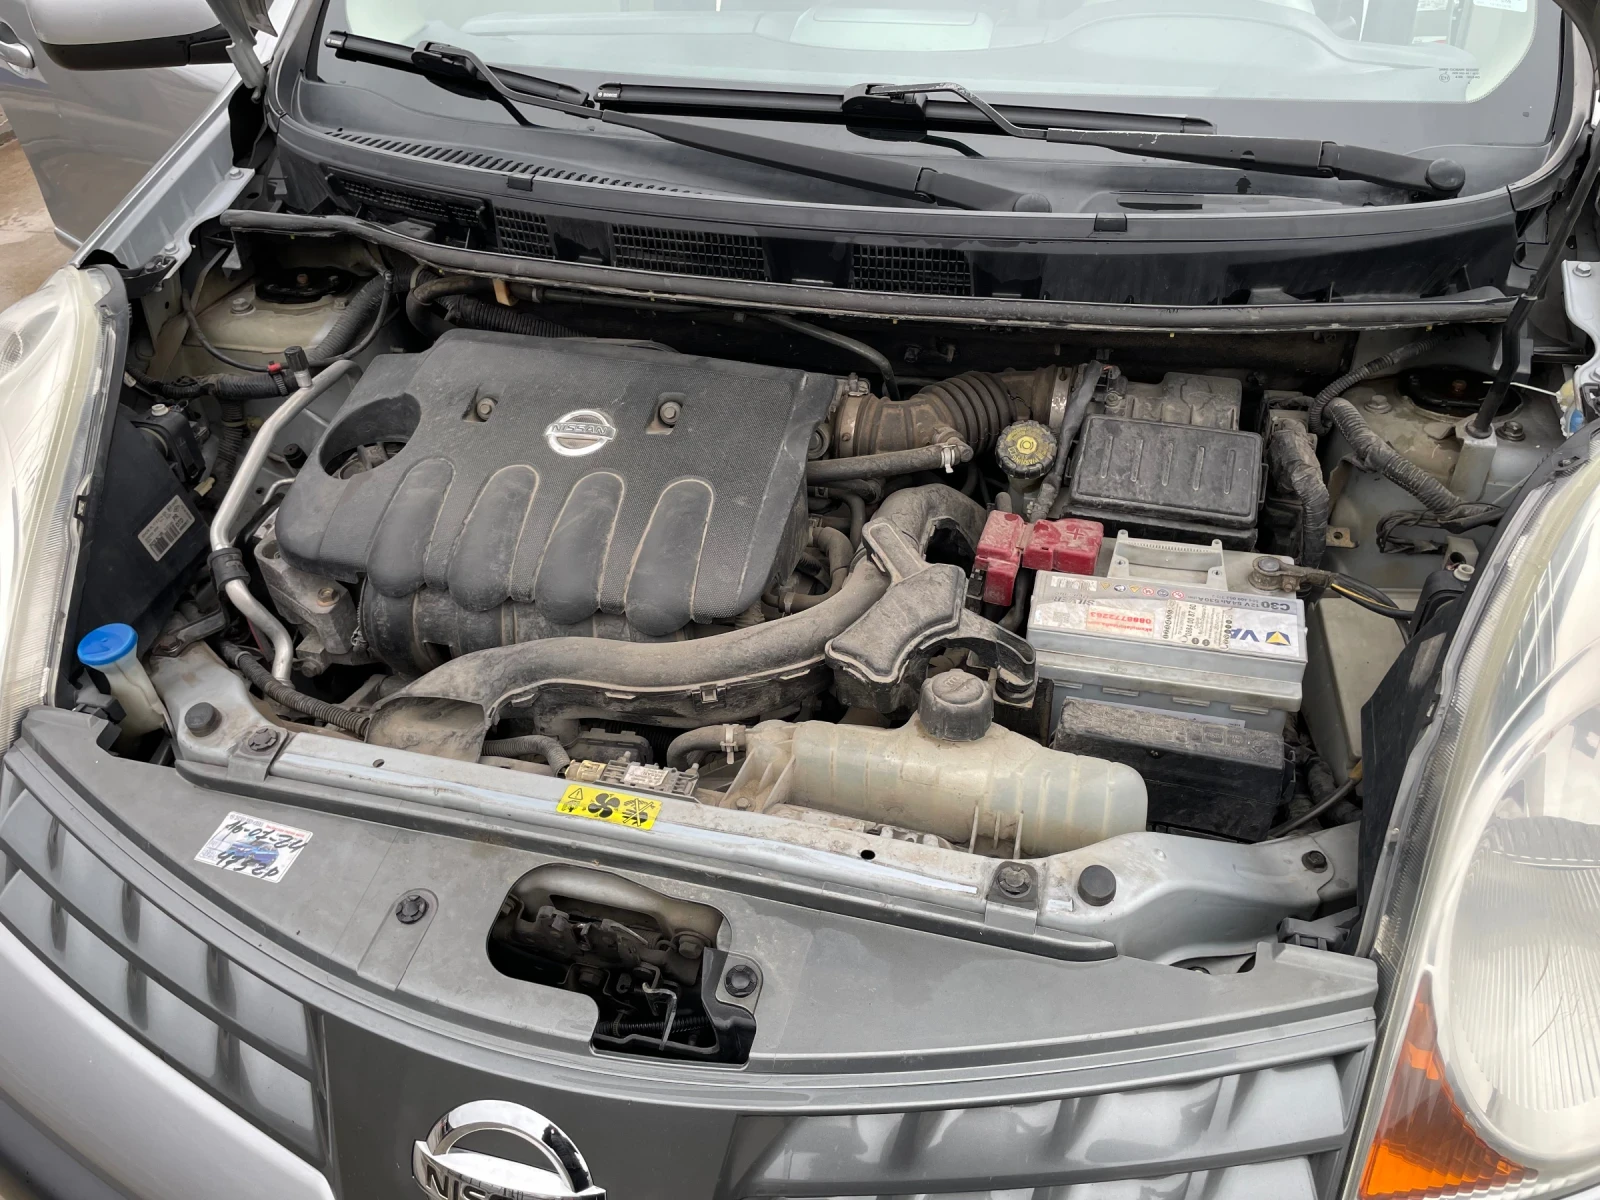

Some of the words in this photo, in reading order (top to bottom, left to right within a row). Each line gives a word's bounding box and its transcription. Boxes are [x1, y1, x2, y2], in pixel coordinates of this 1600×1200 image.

[552, 423, 606, 434] NISSAN
[1260, 600, 1290, 611] C30
[1090, 612, 1151, 624] 0888772263
[225, 820, 308, 853] 16-07-24
